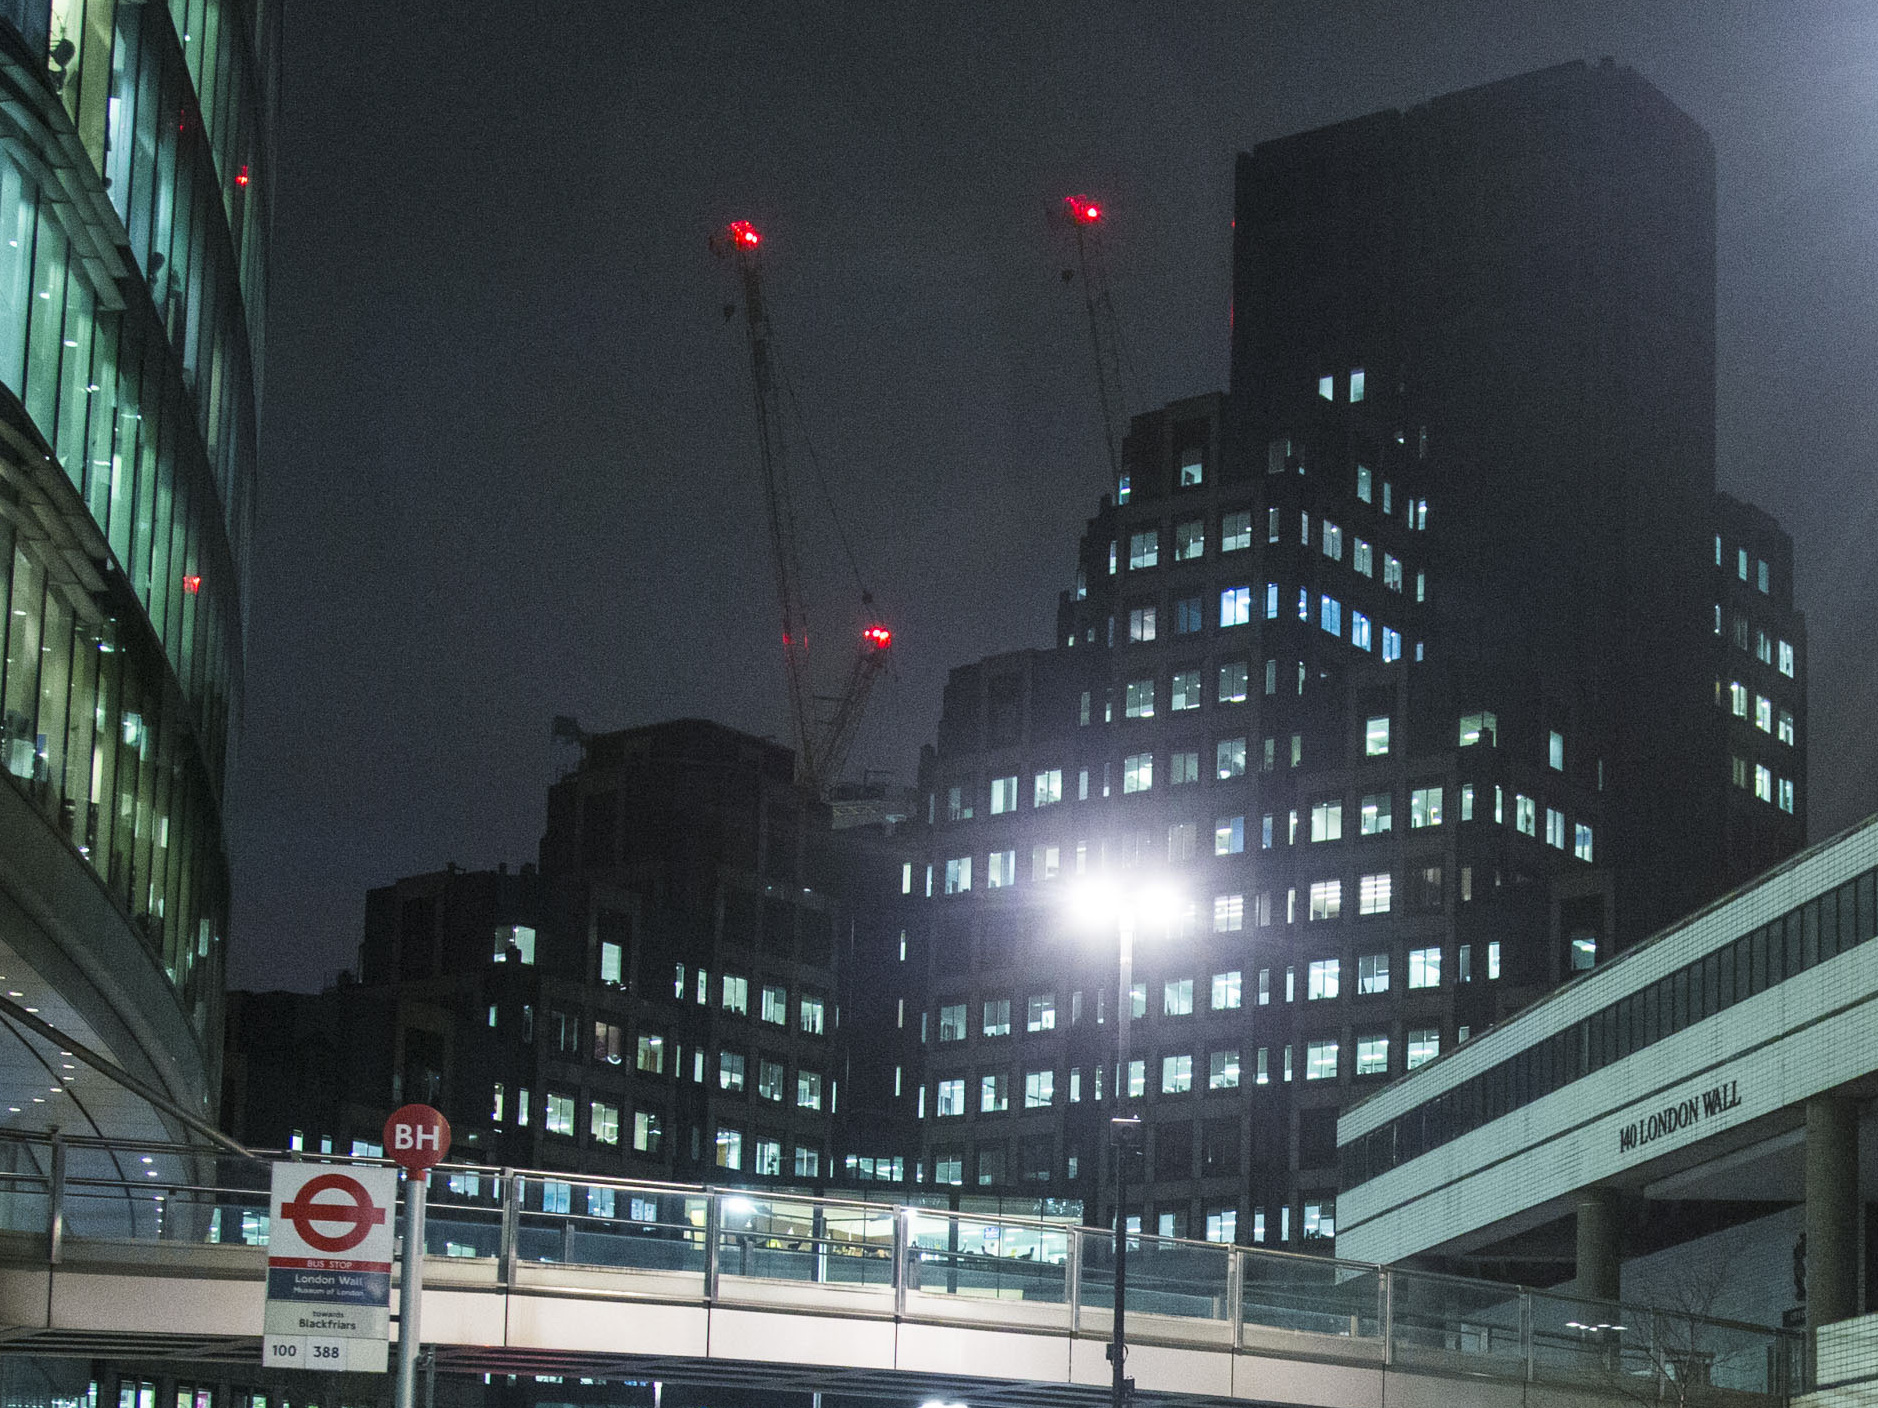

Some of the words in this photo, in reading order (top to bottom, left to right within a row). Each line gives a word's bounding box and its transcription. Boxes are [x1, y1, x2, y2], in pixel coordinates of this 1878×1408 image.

[1619, 1123, 1637, 1153] 140
[1639, 1096, 1699, 1145] LONDON
[1702, 1080, 1742, 1118] WALL
[394, 1123, 440, 1151] BH
[306, 1260, 325, 1269] BUS
[329, 1260, 353, 1270] STOP
[294, 1273, 335, 1285] London
[338, 1274, 363, 1287] Wall
[293, 1286, 325, 1295] Museum
[326, 1286, 335, 1296] of
[336, 1287, 364, 1297] London
[312, 1310, 345, 1318] towards
[298, 1318, 357, 1330] Blackfriars
[272, 1344, 297, 1357] 100
[312, 1345, 340, 1359] 388
